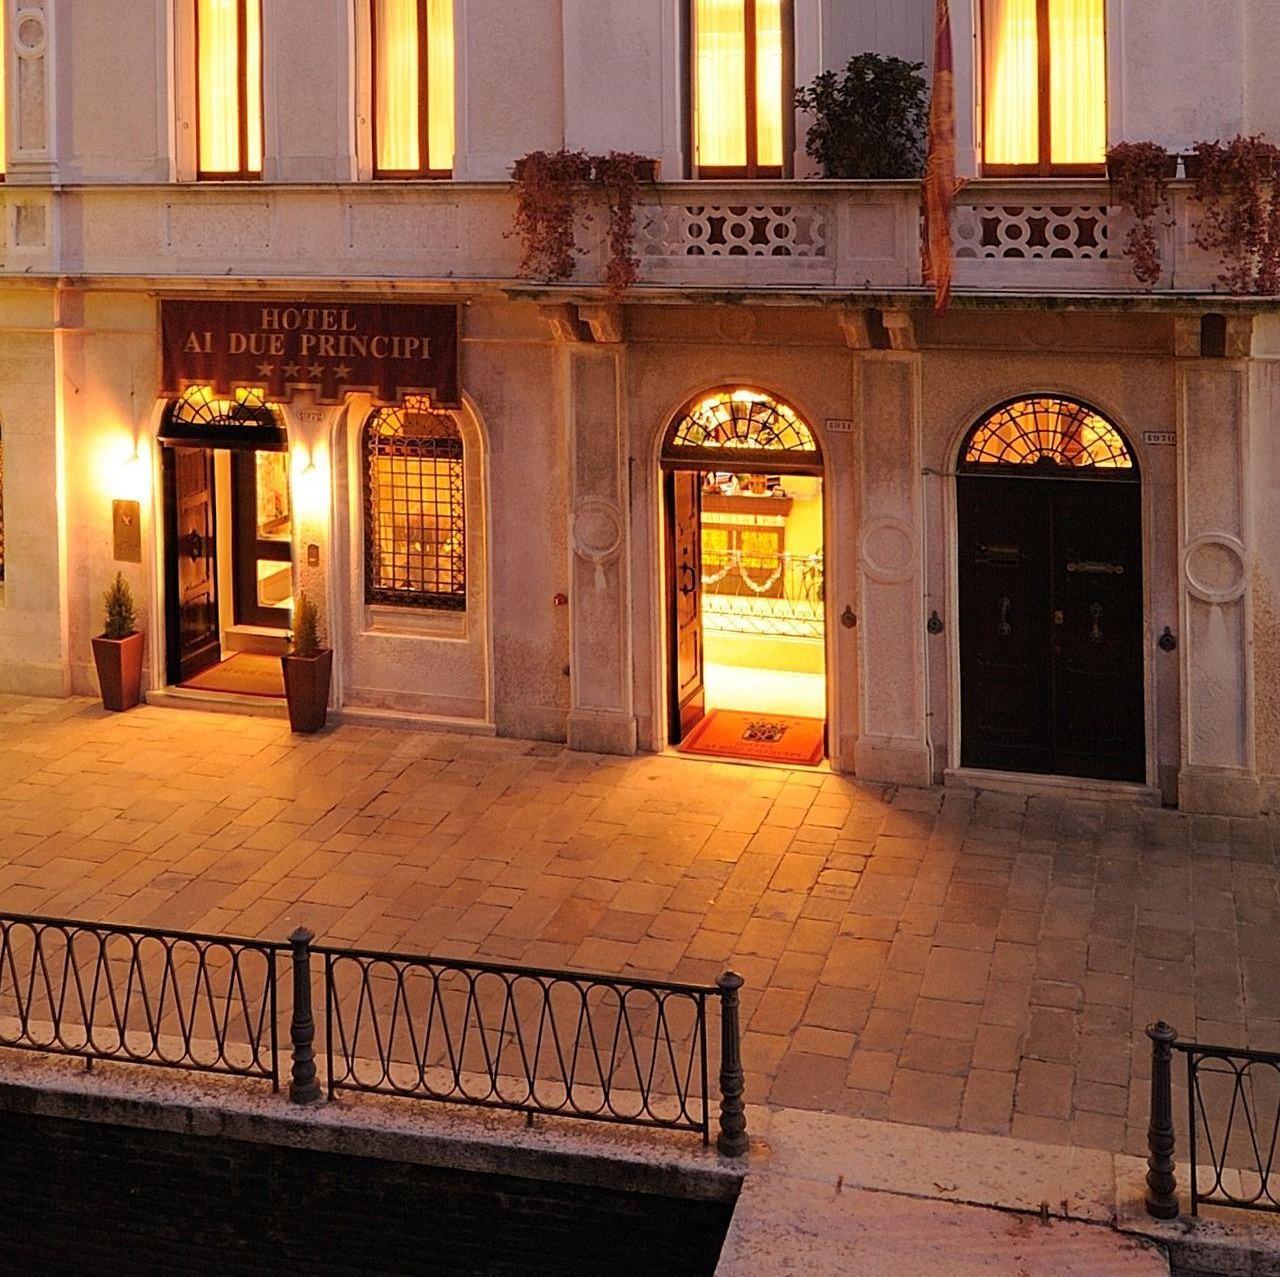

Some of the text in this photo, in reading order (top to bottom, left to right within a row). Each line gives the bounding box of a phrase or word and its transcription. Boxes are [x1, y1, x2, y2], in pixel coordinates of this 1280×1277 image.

[261, 307, 357, 332] HOTEL
[183, 331, 433, 360] AI DUE PRINCIPI
